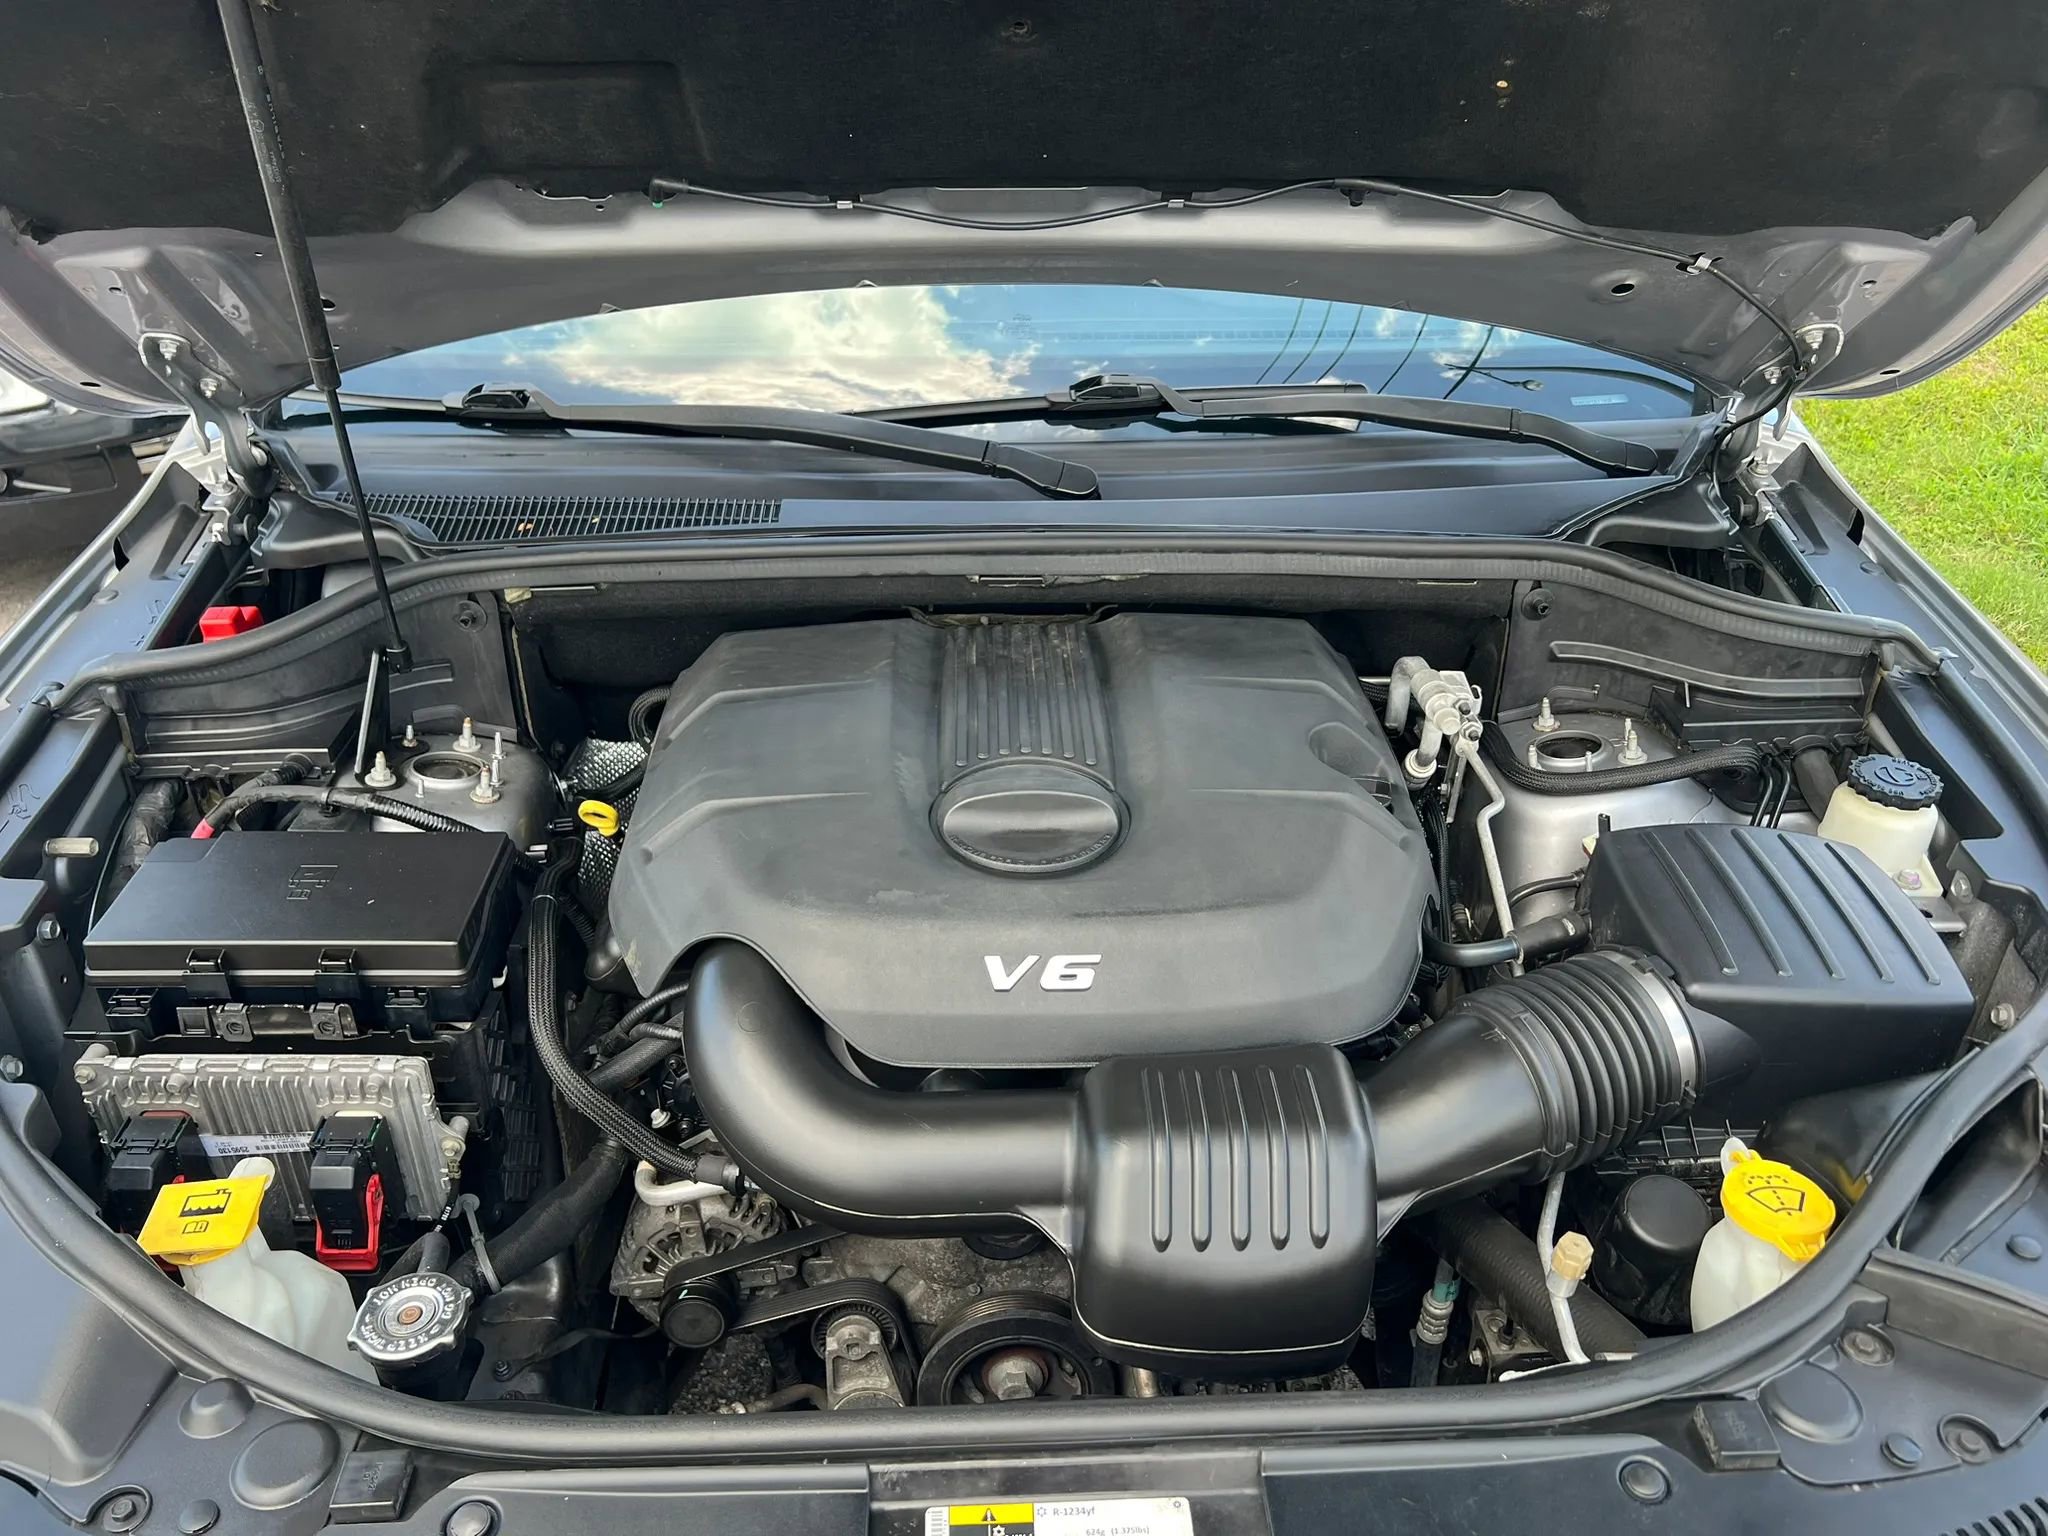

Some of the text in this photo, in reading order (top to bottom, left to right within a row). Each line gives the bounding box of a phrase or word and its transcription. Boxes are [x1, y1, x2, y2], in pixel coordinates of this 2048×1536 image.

[983, 953, 1103, 992] V6
[401, 1277, 437, 1289] OPEN
[436, 1283, 455, 1302] NOT
[441, 1303, 455, 1319] DO
[361, 1325, 429, 1351] KEEP TIGHT
[1053, 1506, 1095, 1517] R-1234yf
[1086, 1528, 1106, 1536] 624g
